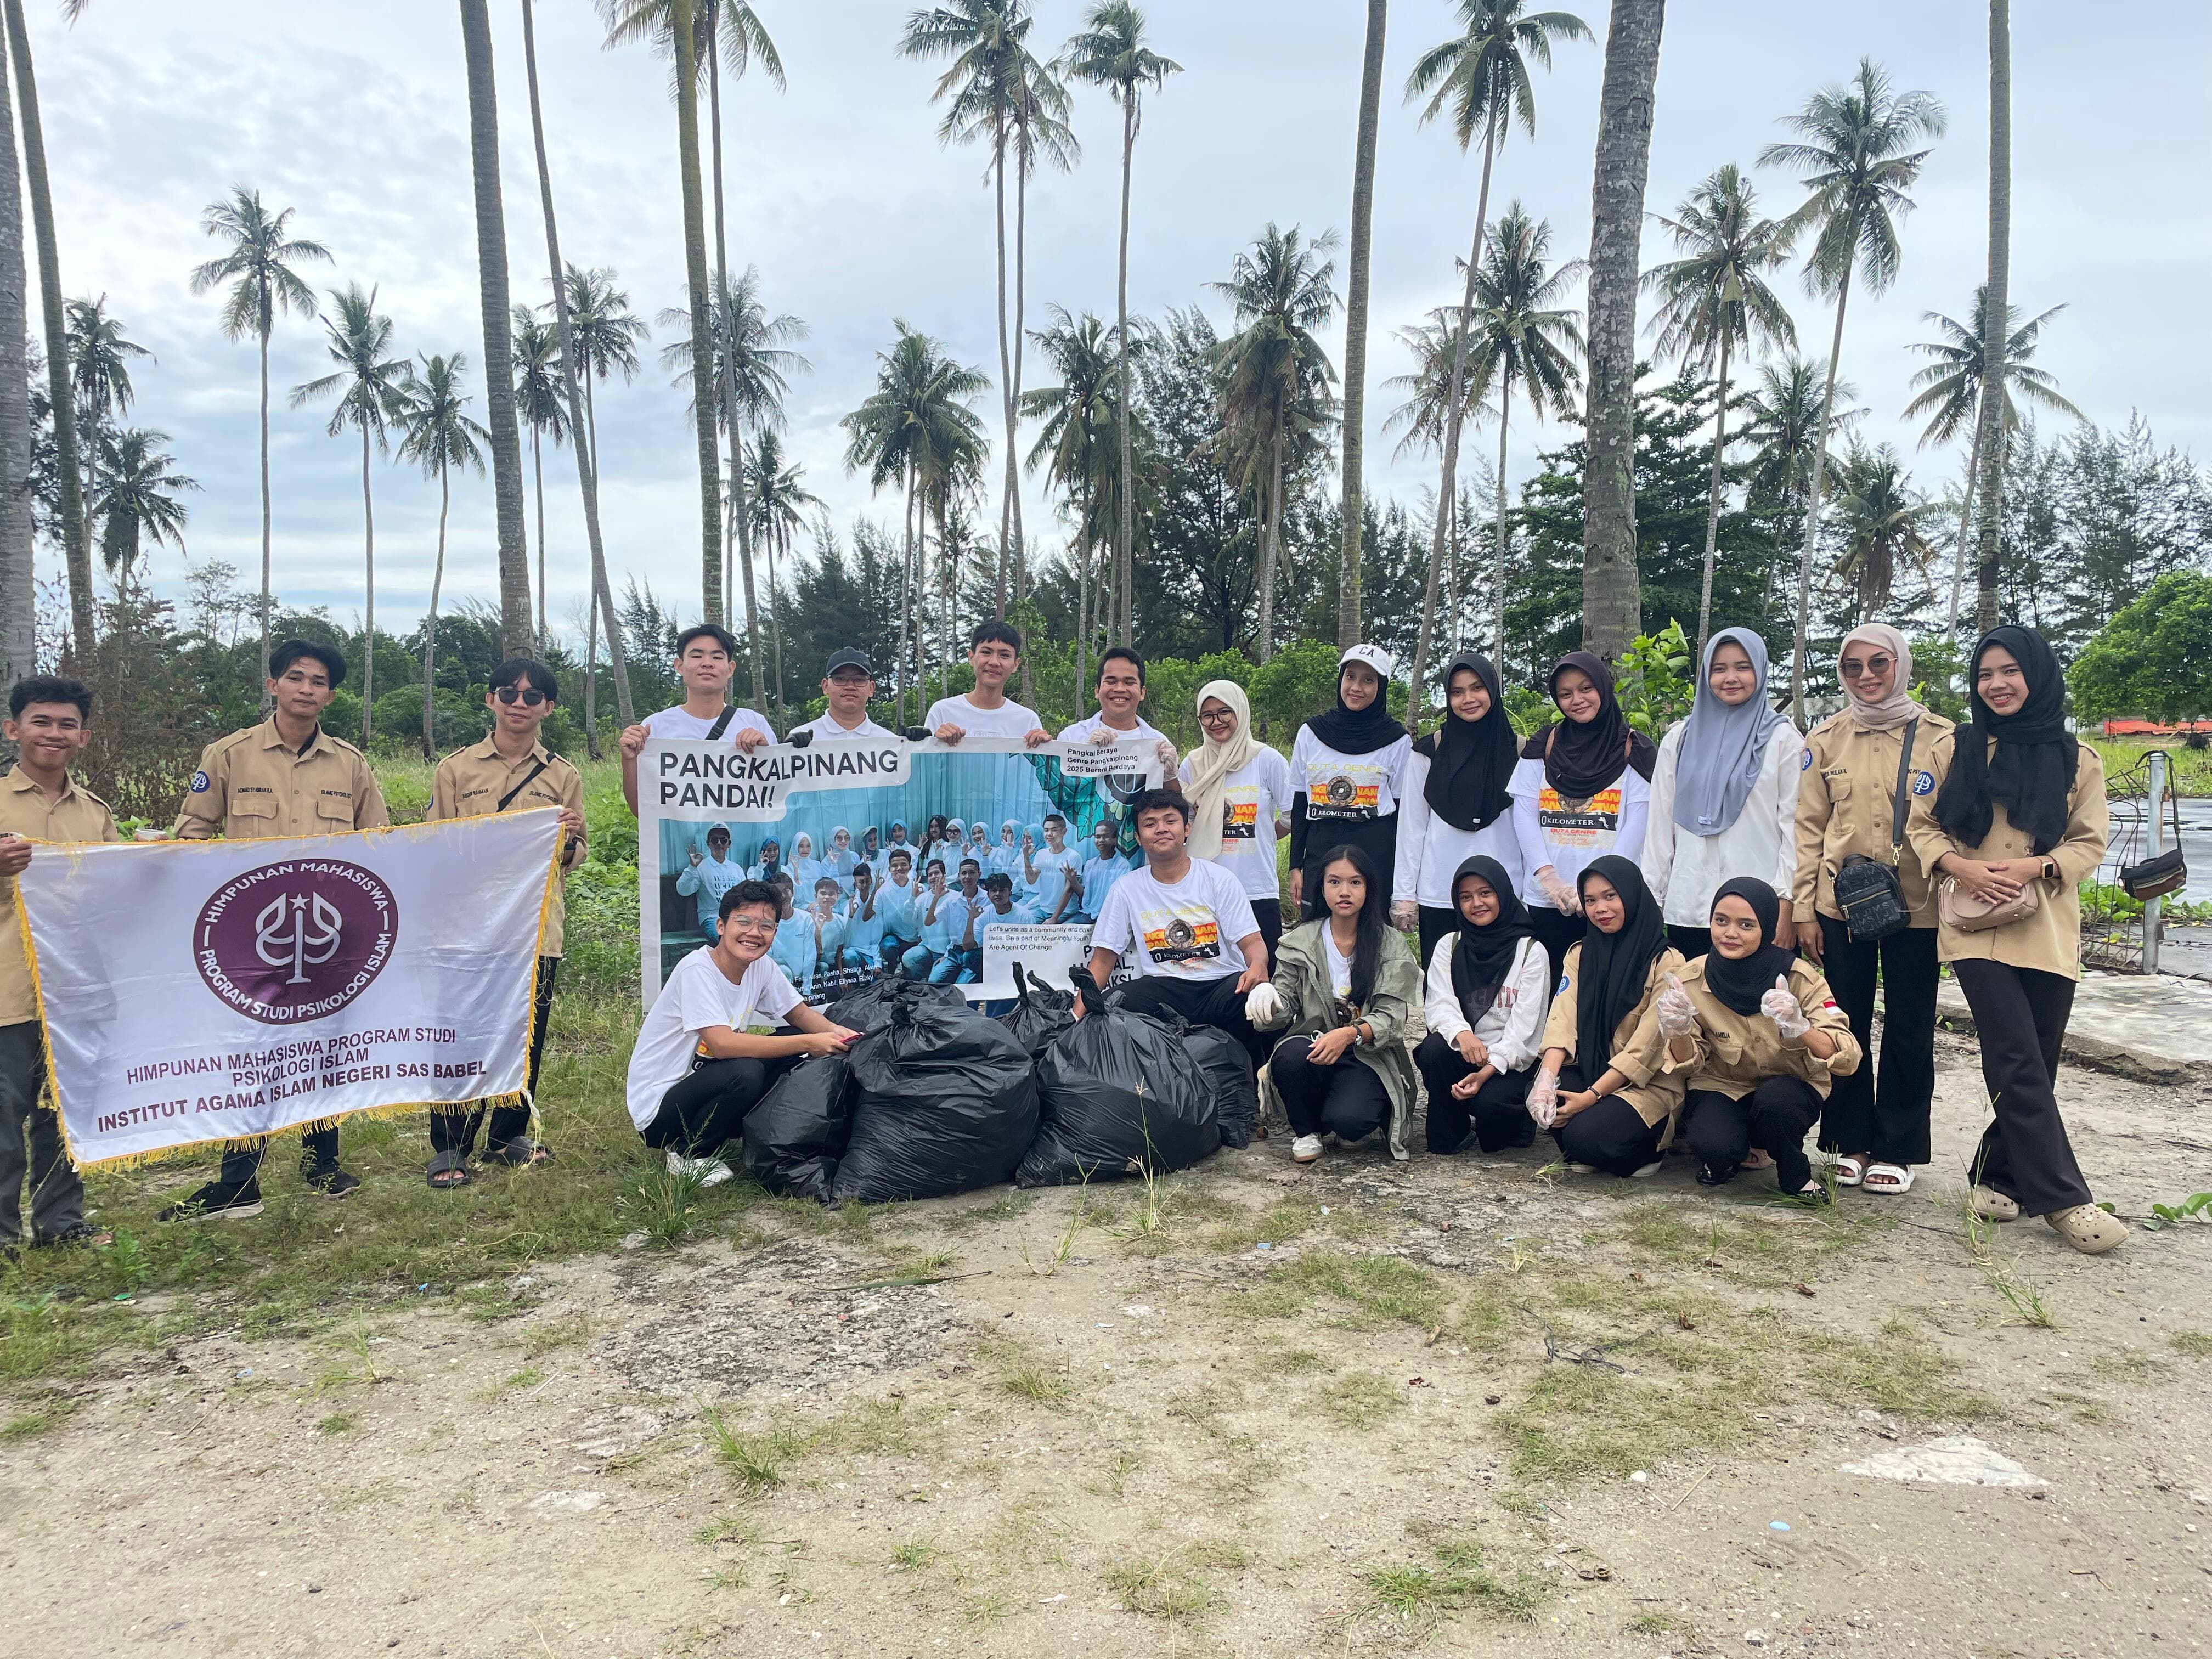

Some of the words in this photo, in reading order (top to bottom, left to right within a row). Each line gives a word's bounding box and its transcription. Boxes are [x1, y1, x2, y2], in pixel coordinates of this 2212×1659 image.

[1359, 646, 1374, 657] CA
[660, 750, 898, 781] PANGKALPINANG
[1068, 748, 1095, 757] Pangkal
[1090, 755, 1138, 765] Pangkalpinang
[661, 782, 775, 809] PANDAI!
[1311, 808, 1317, 816] 0
[1542, 815, 1547, 825] 0
[1547, 817, 1594, 826] KILOMETER
[205, 864, 294, 923] HIMPUNAN
[300, 862, 388, 911] MAHASISWA
[199, 949, 253, 1009] PROGRAM
[251, 1001, 294, 1019] STUDI
[297, 971, 371, 1018] PSIKOLOGI
[364, 933, 392, 972] ISLAM
[127, 1056, 222, 1085] HIMPUNAN
[228, 1040, 324, 1070] MAHASISWA
[328, 1028, 410, 1053] PROGRAM
[415, 1028, 456, 1043] STUDI
[233, 1058, 314, 1087] PSIKOLOGI
[320, 1047, 369, 1070] ISLAM
[98, 1099, 188, 1132] INSTITUT
[195, 1091, 266, 1113] AGAMA
[270, 1076, 316, 1103] ISLAM
[322, 1064, 390, 1089] NEGERI
[397, 1063, 429, 1077] SAS
[434, 1060, 487, 1079] BABEL
